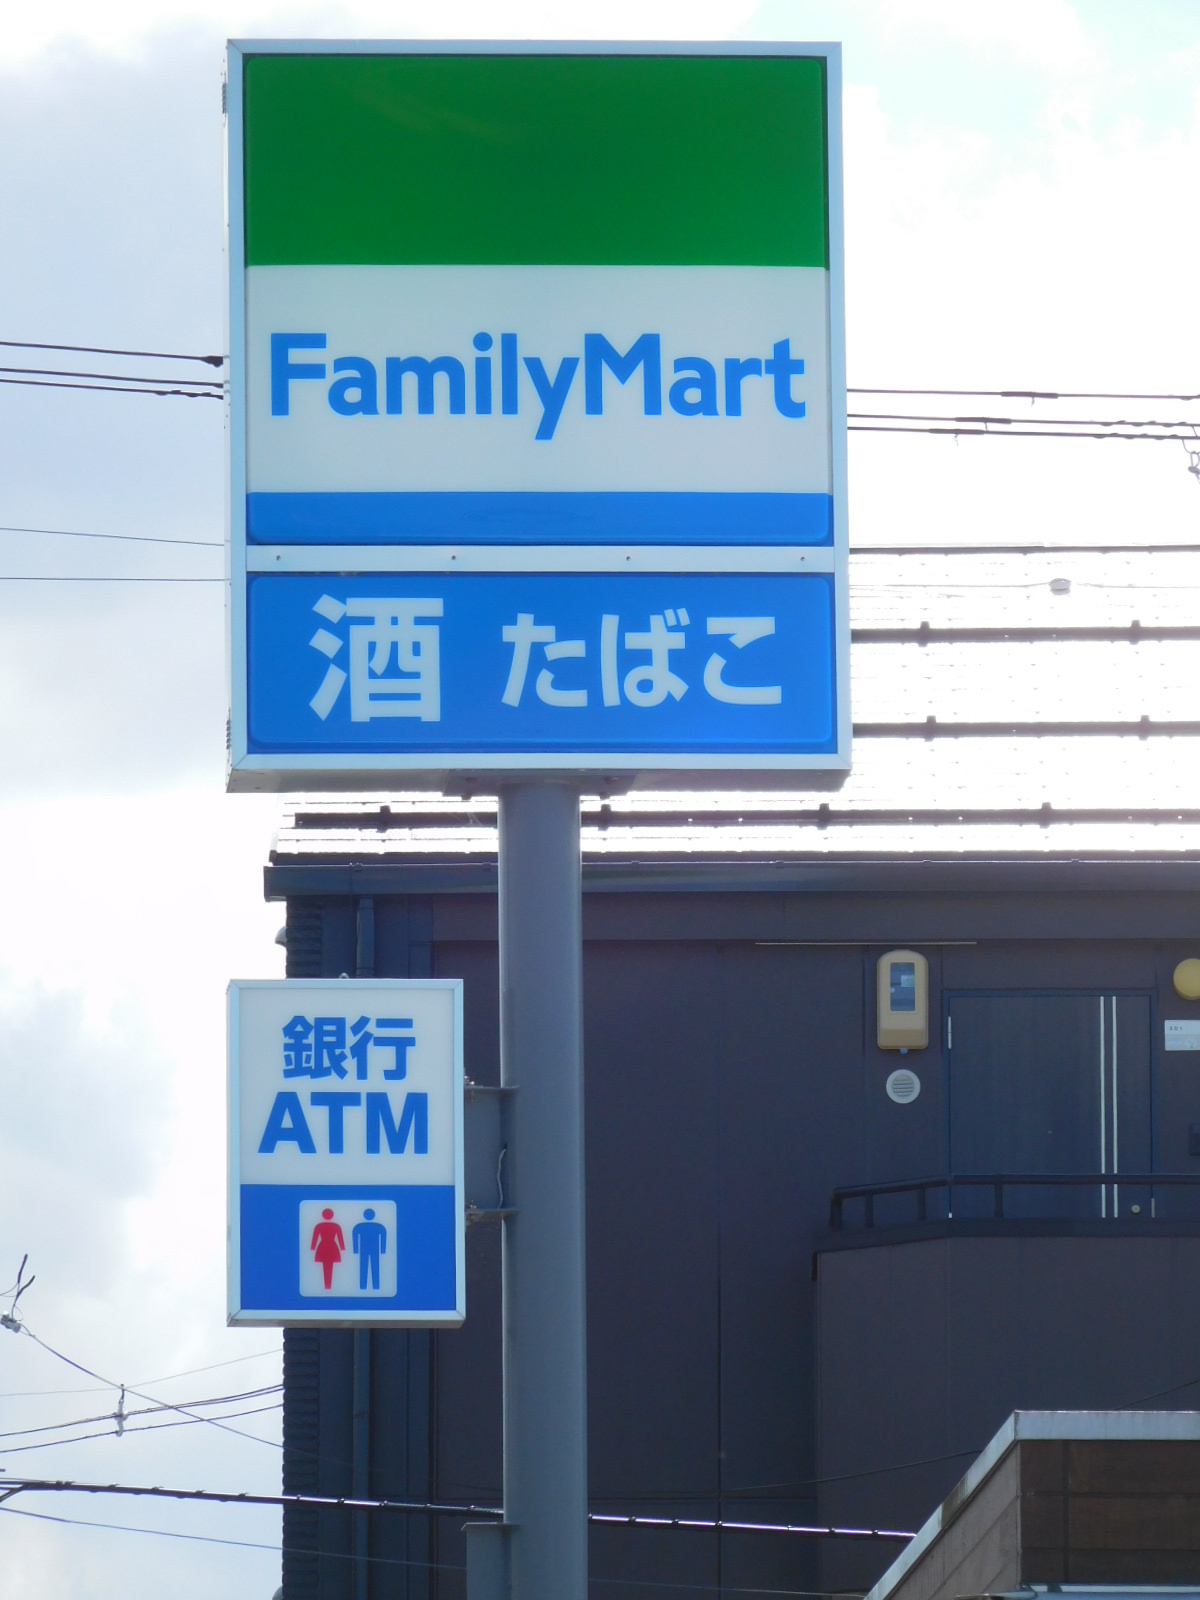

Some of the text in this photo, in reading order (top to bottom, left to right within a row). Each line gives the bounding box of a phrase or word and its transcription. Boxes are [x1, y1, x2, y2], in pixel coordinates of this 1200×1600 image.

[270, 331, 806, 440] FamilyMart
[309, 593, 782, 722] 酒 たばこ
[282, 1015, 416, 1081] 銀行
[257, 1091, 428, 1155] ATM
